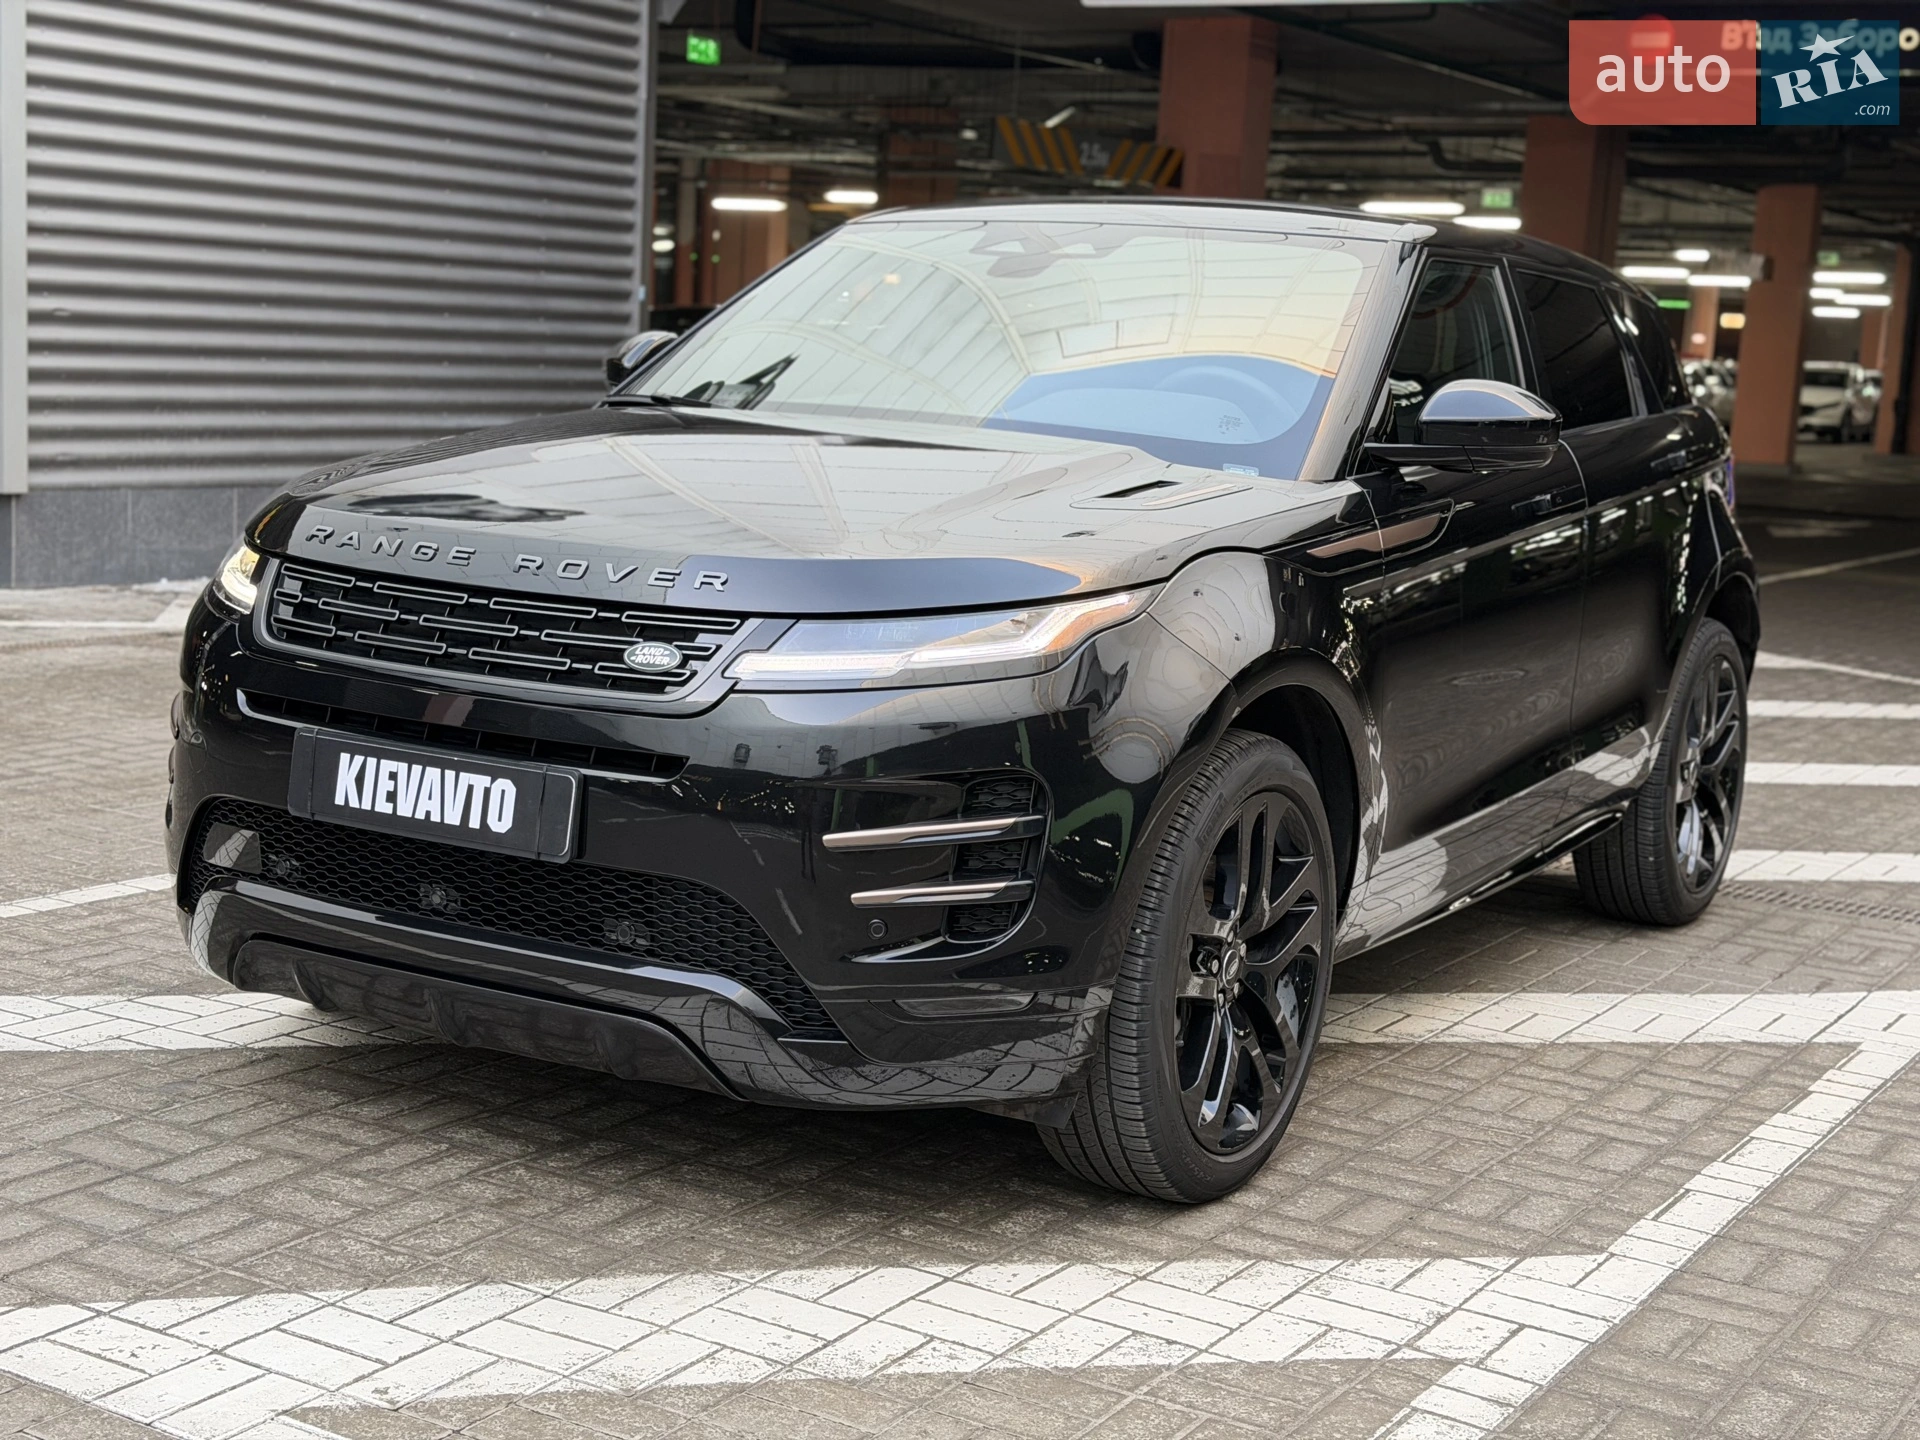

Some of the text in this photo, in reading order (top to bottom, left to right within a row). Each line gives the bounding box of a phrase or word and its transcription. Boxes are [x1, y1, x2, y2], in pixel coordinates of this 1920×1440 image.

[305, 525, 729, 592] RANGE ROVER
[635, 646, 664, 656] LAND
[635, 655, 670, 665] ROVER
[334, 752, 517, 834] KIEVAVTO
